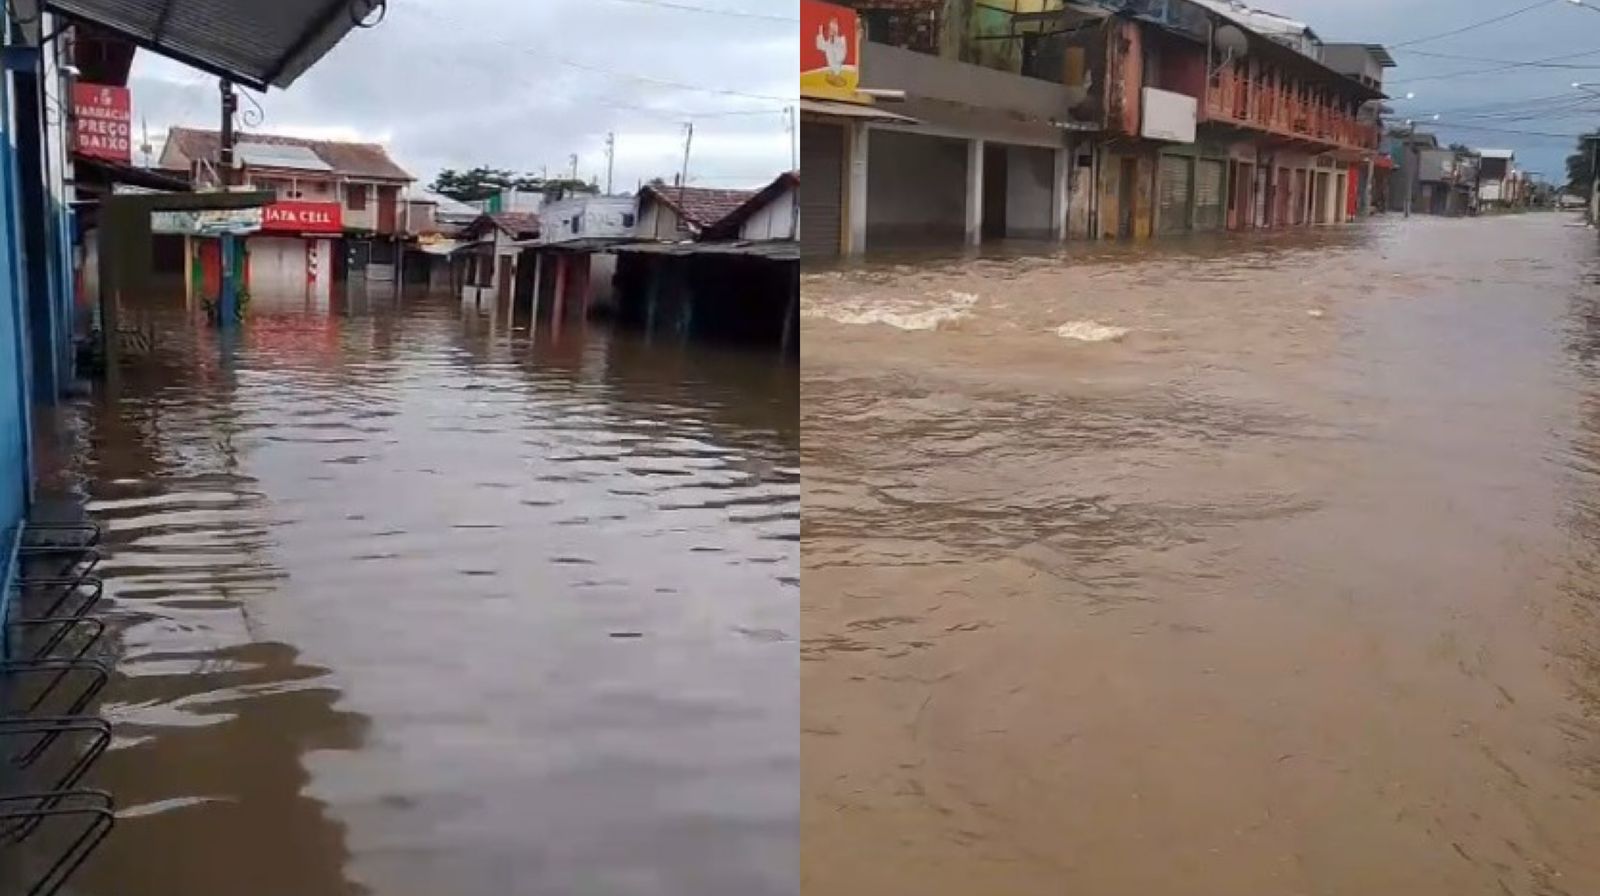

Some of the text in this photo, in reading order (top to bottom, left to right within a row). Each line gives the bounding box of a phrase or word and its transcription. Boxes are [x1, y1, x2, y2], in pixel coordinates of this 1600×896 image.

[79, 119, 128, 138] PREÇO
[80, 134, 128, 151] BAIXO
[299, 210, 331, 223] CELL
